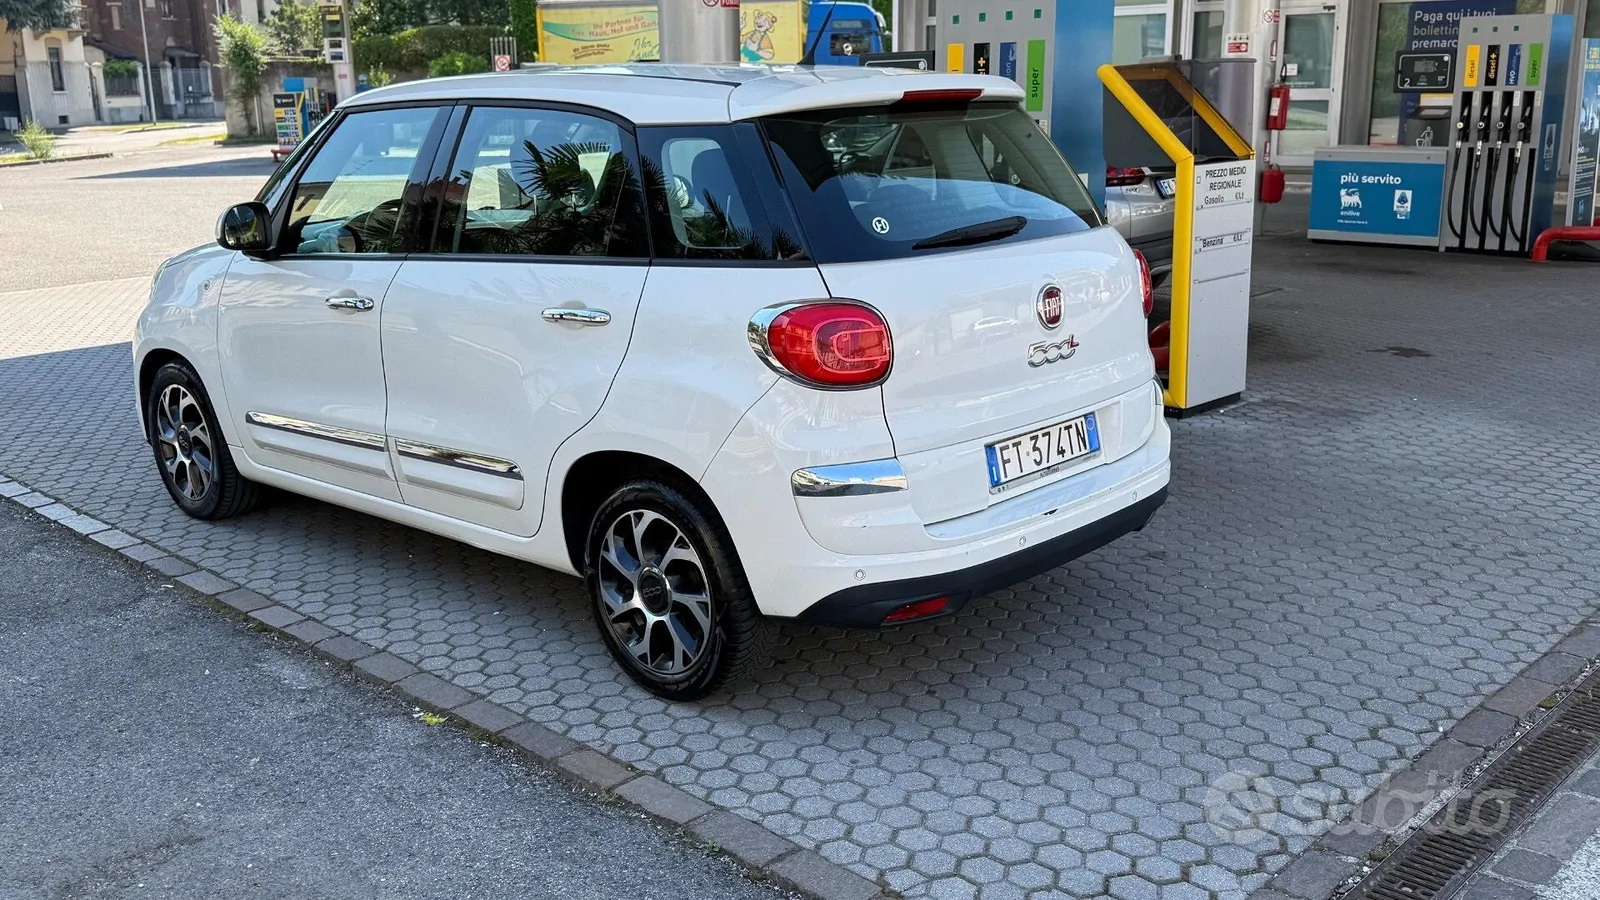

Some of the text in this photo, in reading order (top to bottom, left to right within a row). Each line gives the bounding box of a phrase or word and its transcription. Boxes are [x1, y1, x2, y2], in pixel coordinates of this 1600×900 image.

[1414, 11, 1443, 23] Paga
[1446, 9, 1463, 23] qui
[605, 17, 632, 29] Partner
[641, 20, 659, 29] Gart
[1413, 24, 1459, 36] bollettin
[1411, 39, 1458, 51] premarc
[1531, 60, 1539, 78] super
[1031, 68, 1041, 98] super
[1403, 78, 1411, 88] 2
[1205, 166, 1247, 178] PREZZO MEDIO
[1340, 172, 1402, 185] più servito
[1209, 179, 1242, 191] REGIONALE
[1204, 195, 1225, 205] Gasolio
[1202, 237, 1224, 248] Benzina
[1044, 297, 1061, 318] FIAT
[1028, 334, 1079, 368] 500L
[643, 586, 662, 598] 500
